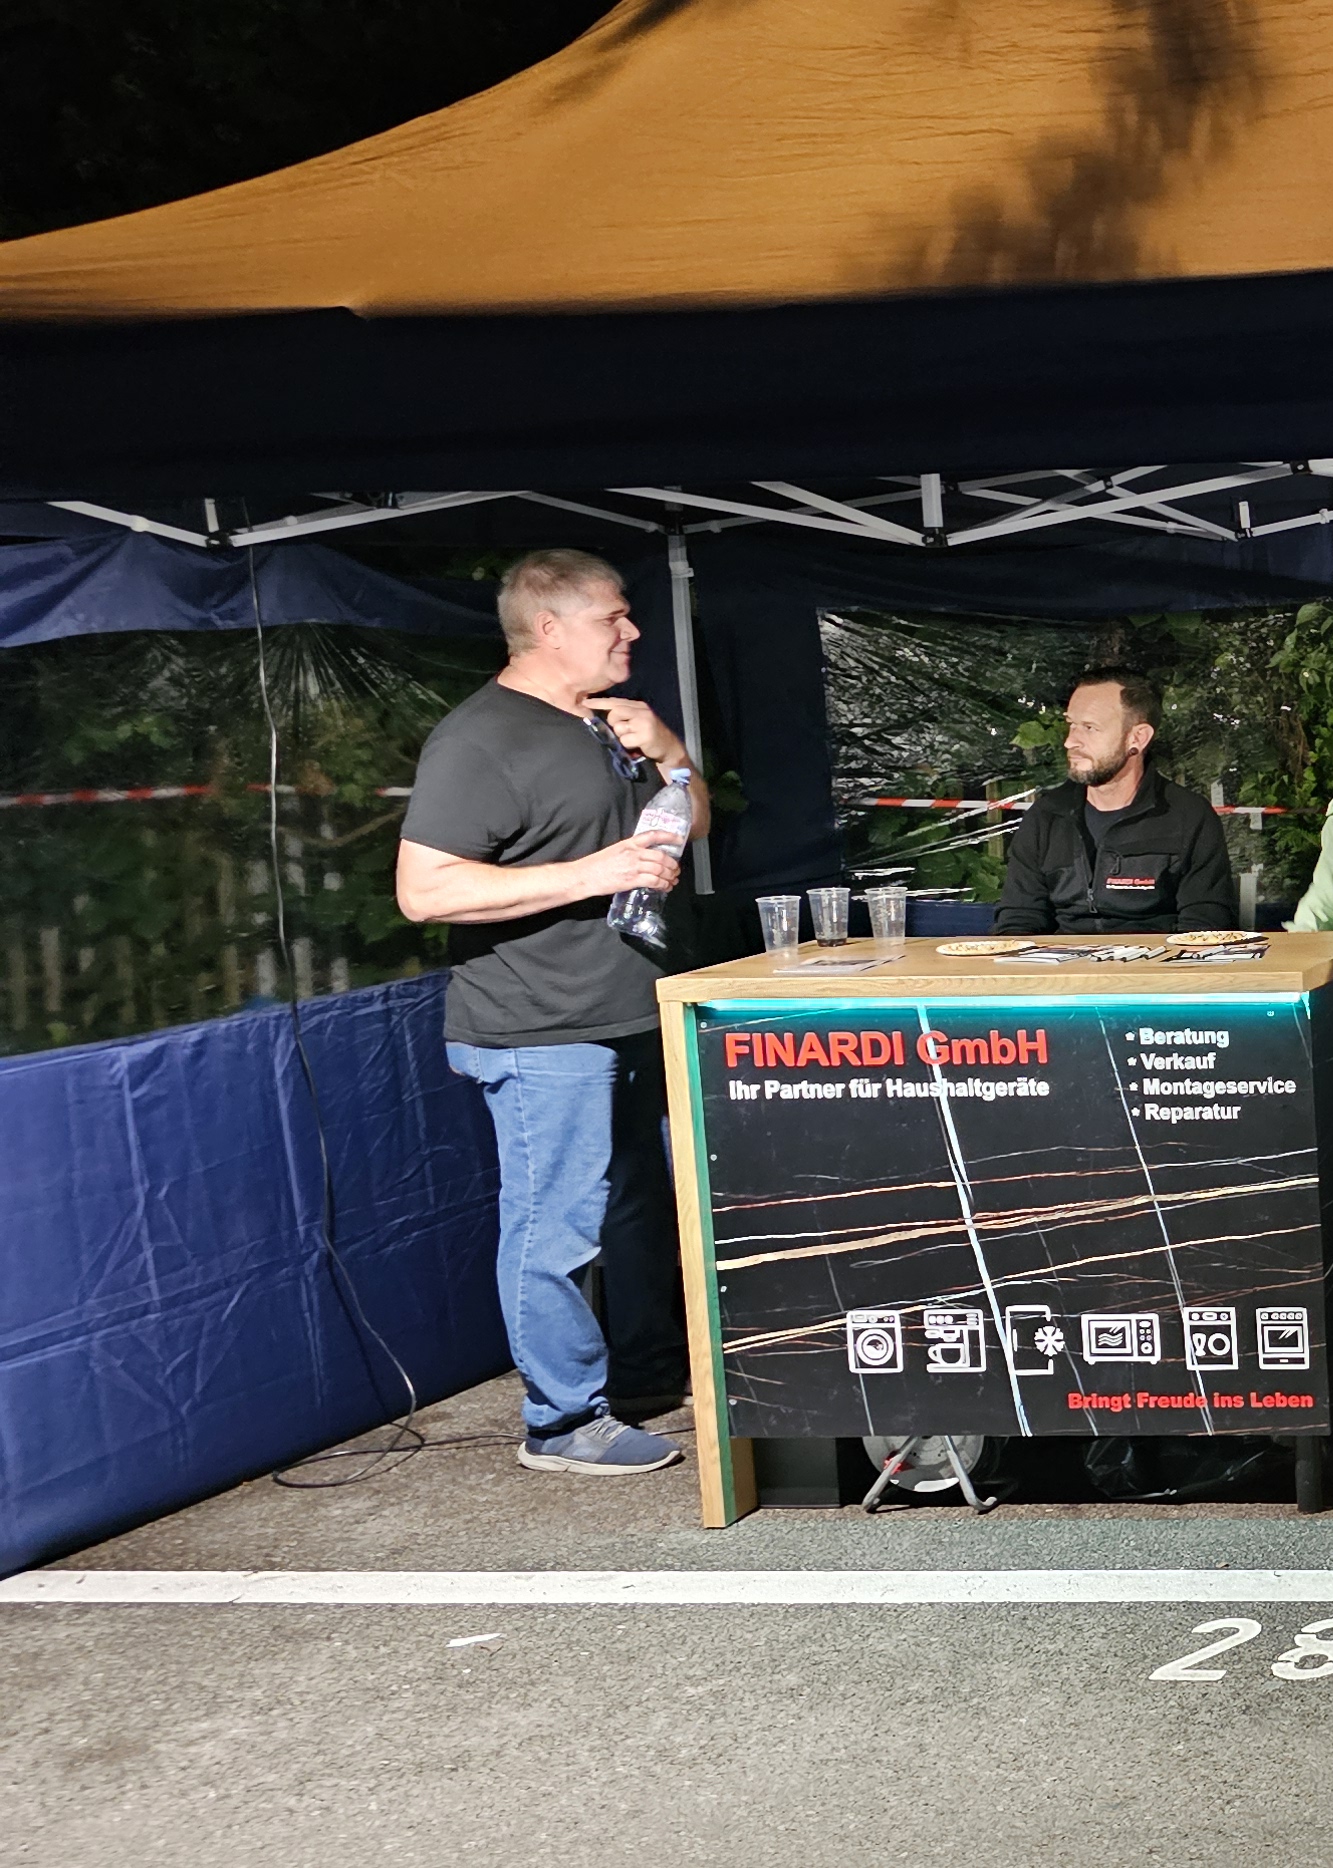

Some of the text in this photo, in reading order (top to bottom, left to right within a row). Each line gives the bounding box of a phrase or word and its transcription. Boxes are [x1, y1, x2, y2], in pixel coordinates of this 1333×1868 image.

[1139, 1027, 1230, 1048] Beratung
[725, 1029, 1048, 1068] FINARDI GmbH
[1140, 1052, 1217, 1071] Verkauf
[729, 1076, 1050, 1102] Ihr Partner für Haushaltgeräte
[1142, 1076, 1297, 1099] Montageservice
[1144, 1103, 1242, 1124] Reparatur
[1068, 1392, 1314, 1413] Bringt Freude ins Leben
